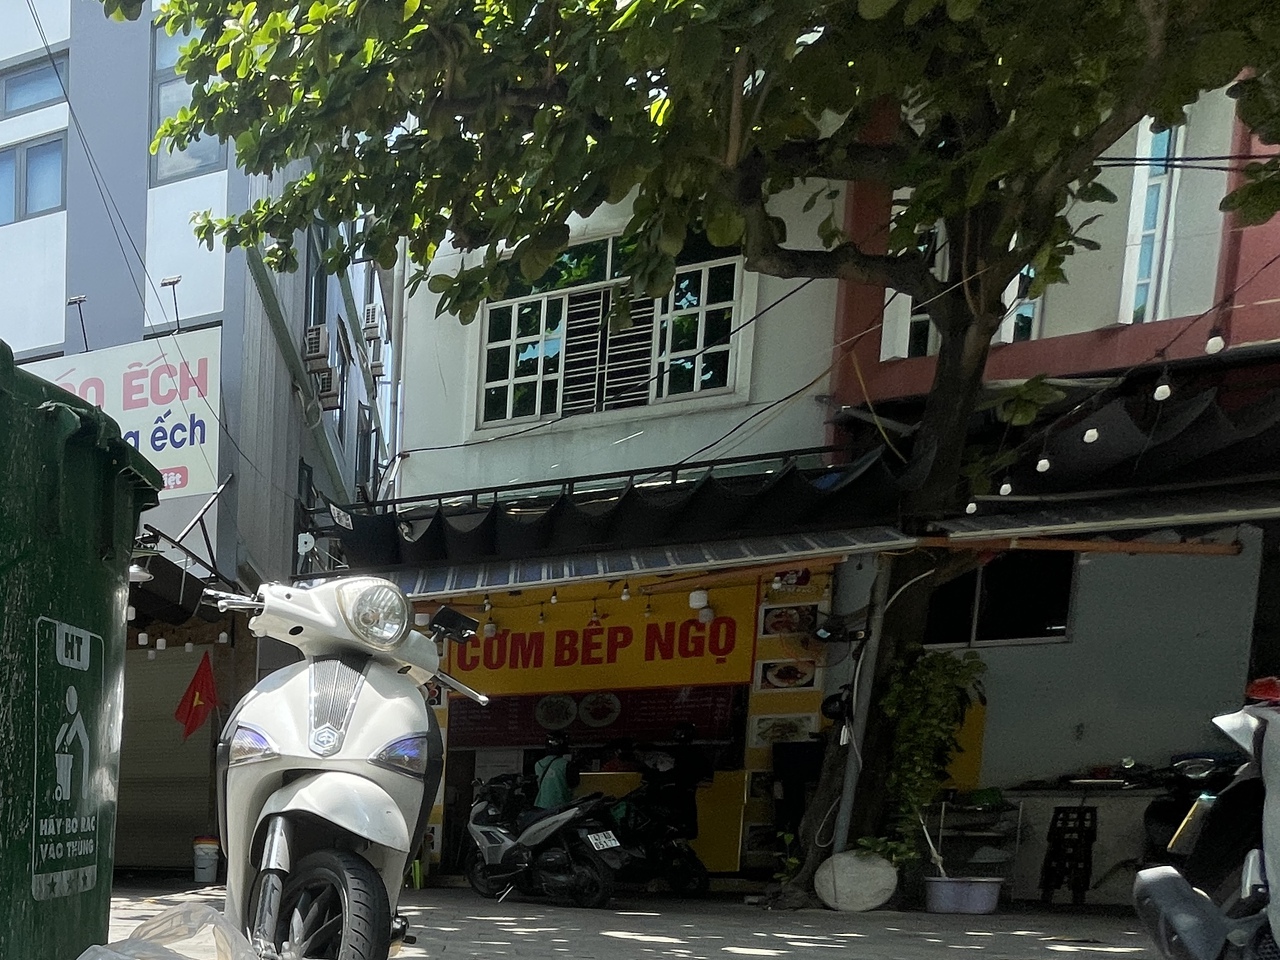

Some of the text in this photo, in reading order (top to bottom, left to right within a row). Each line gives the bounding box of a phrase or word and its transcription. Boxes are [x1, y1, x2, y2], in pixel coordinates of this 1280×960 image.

[122, 353, 208, 411] ẾCH
[150, 409, 206, 452] ếch
[64, 632, 83, 661] HT
[457, 613, 737, 671] CƠM BẾP NGỌ
